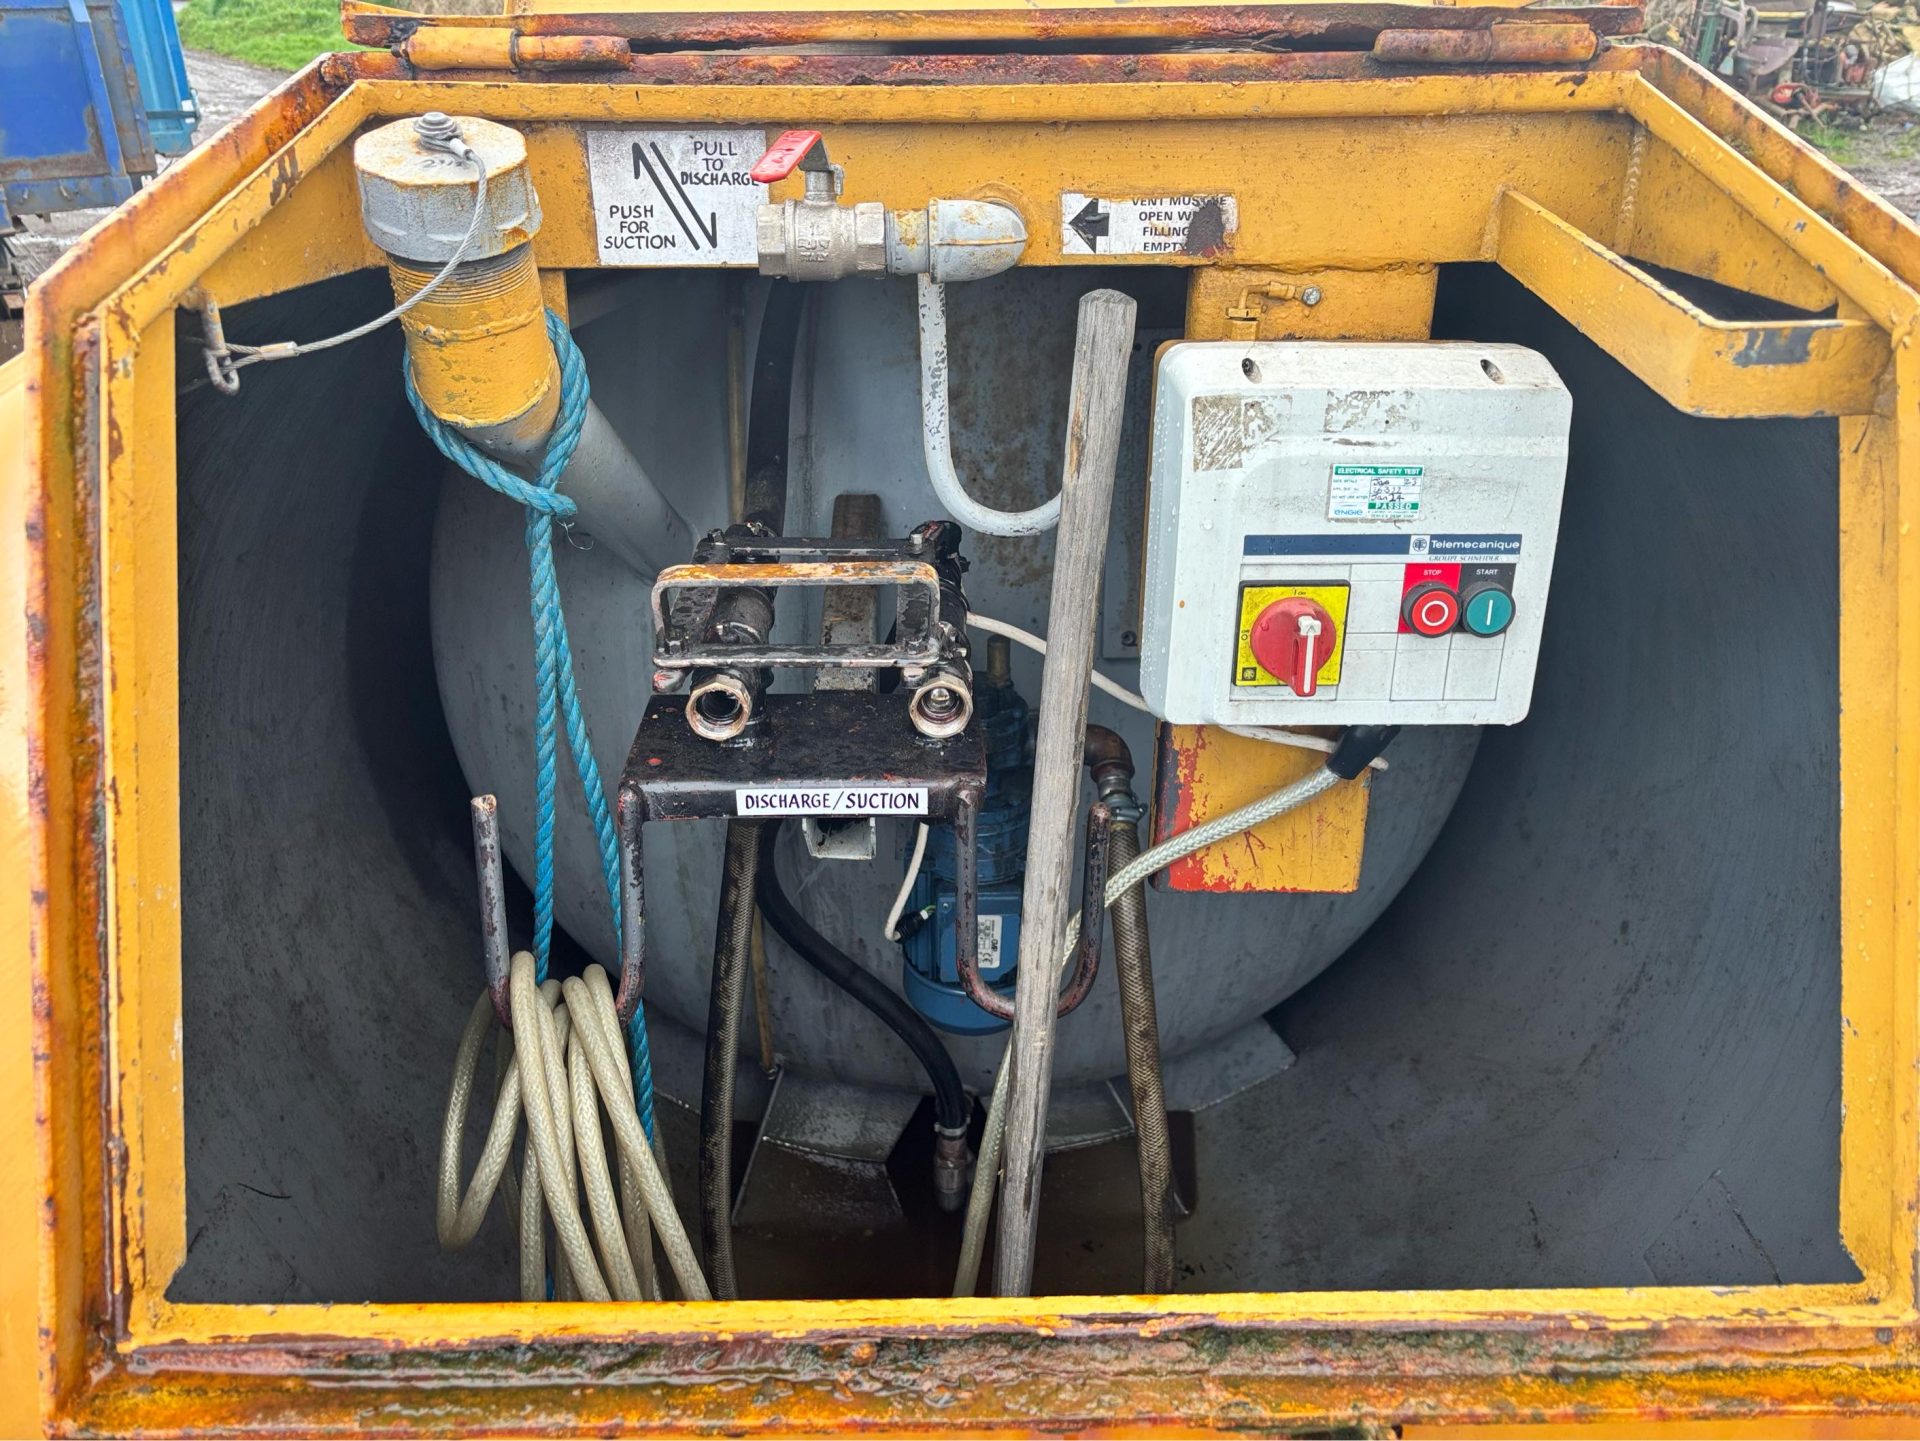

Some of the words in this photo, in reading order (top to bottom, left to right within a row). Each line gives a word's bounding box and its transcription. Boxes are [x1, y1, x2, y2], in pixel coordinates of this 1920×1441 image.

[693, 141, 737, 156] PULL
[702, 158, 723, 171] TO
[1131, 197, 1163, 206] VENT
[609, 204, 654, 219] PUSH
[1138, 211, 1173, 221] OPEN
[620, 220, 650, 234] FOR
[1142, 226, 1189, 237] FILLING
[603, 234, 676, 250] SUCTION
[1337, 467, 1376, 475] ELECTRICAL
[1431, 539, 1520, 551] Telemecanique
[1475, 568, 1499, 576] START
